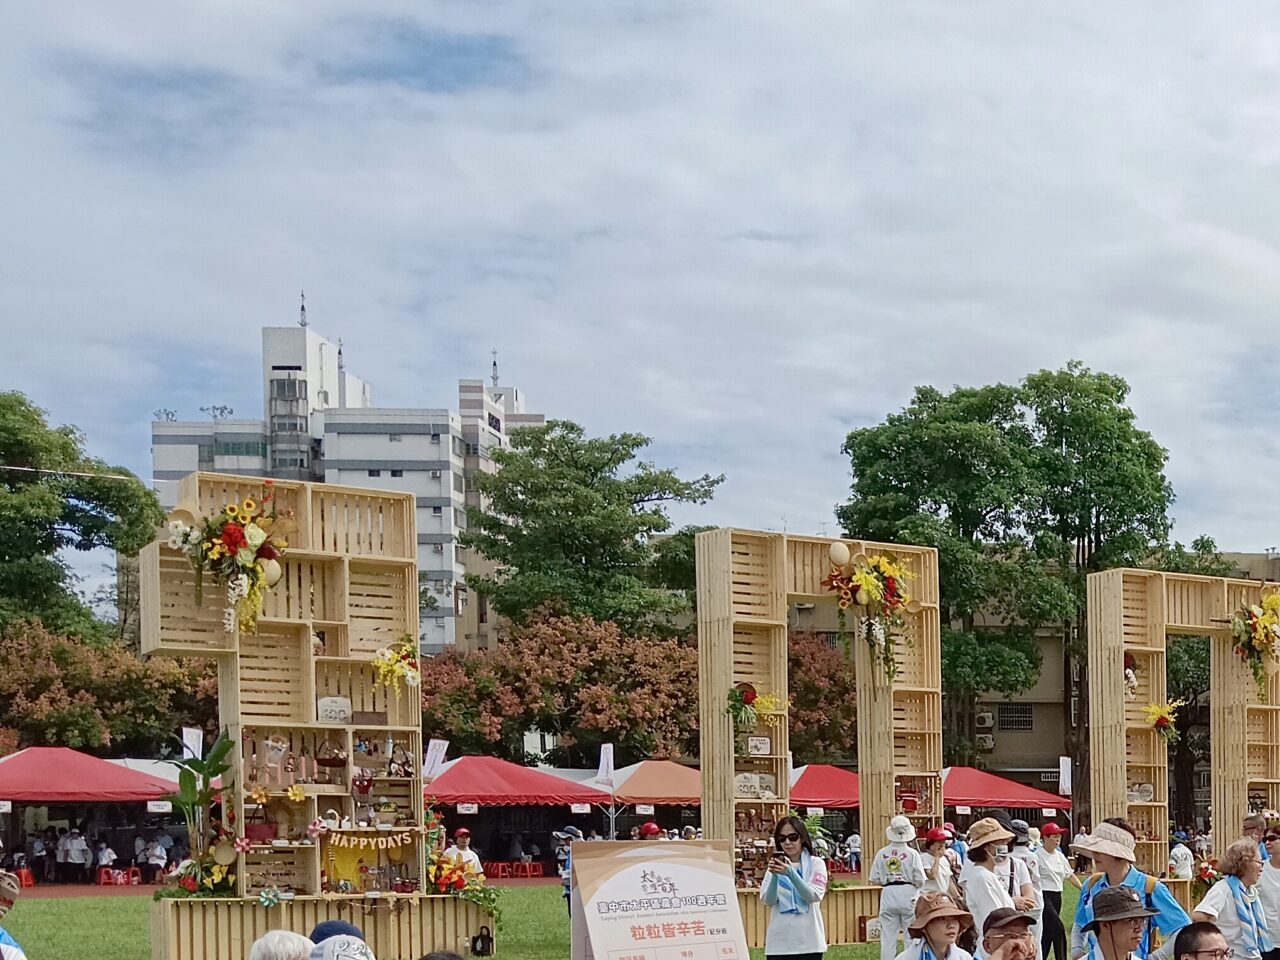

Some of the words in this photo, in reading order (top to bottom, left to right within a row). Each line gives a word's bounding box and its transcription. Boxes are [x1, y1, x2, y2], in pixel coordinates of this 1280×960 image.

[630, 920, 706, 941] 粒粒皆辛苦
